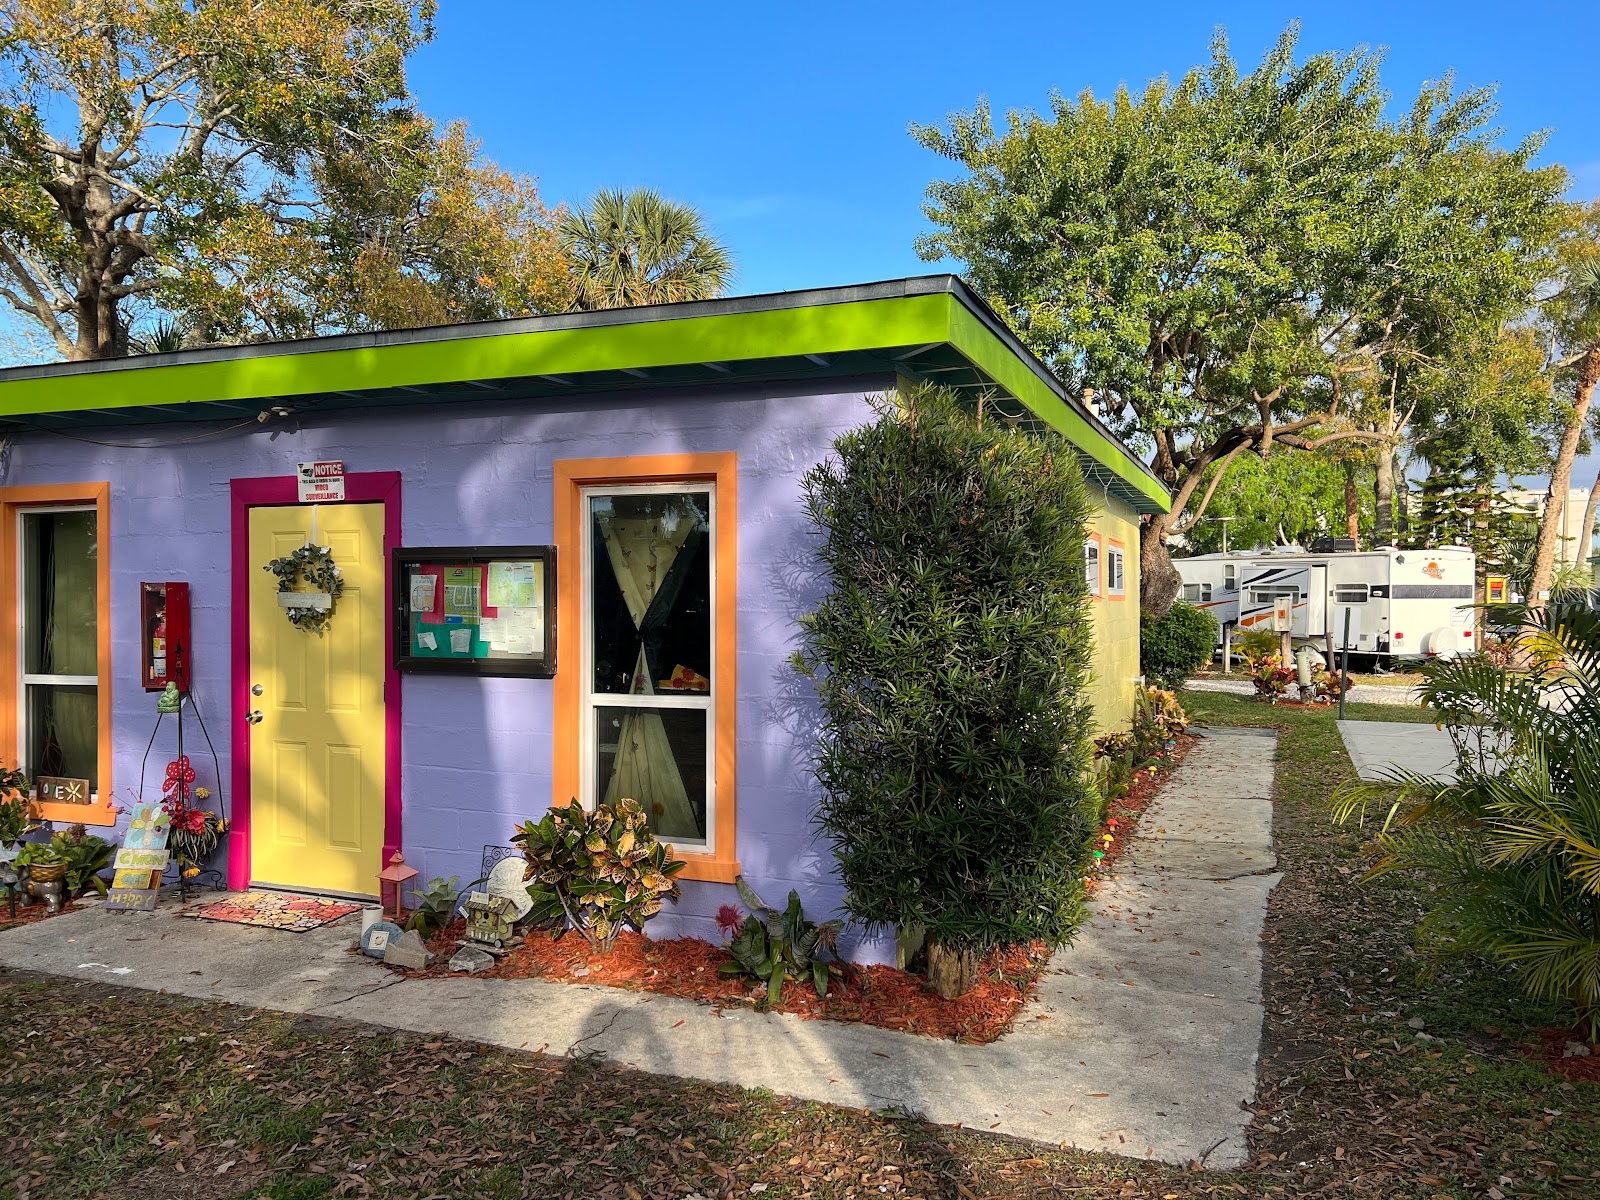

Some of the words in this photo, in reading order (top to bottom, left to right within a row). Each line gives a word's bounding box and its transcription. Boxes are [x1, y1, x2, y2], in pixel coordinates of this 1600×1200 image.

[315, 464, 343, 476] NOTICE
[305, 492, 339, 501] SURVEILLANCE
[119, 850, 164, 866] C'MON
[120, 872, 149, 886] GET
